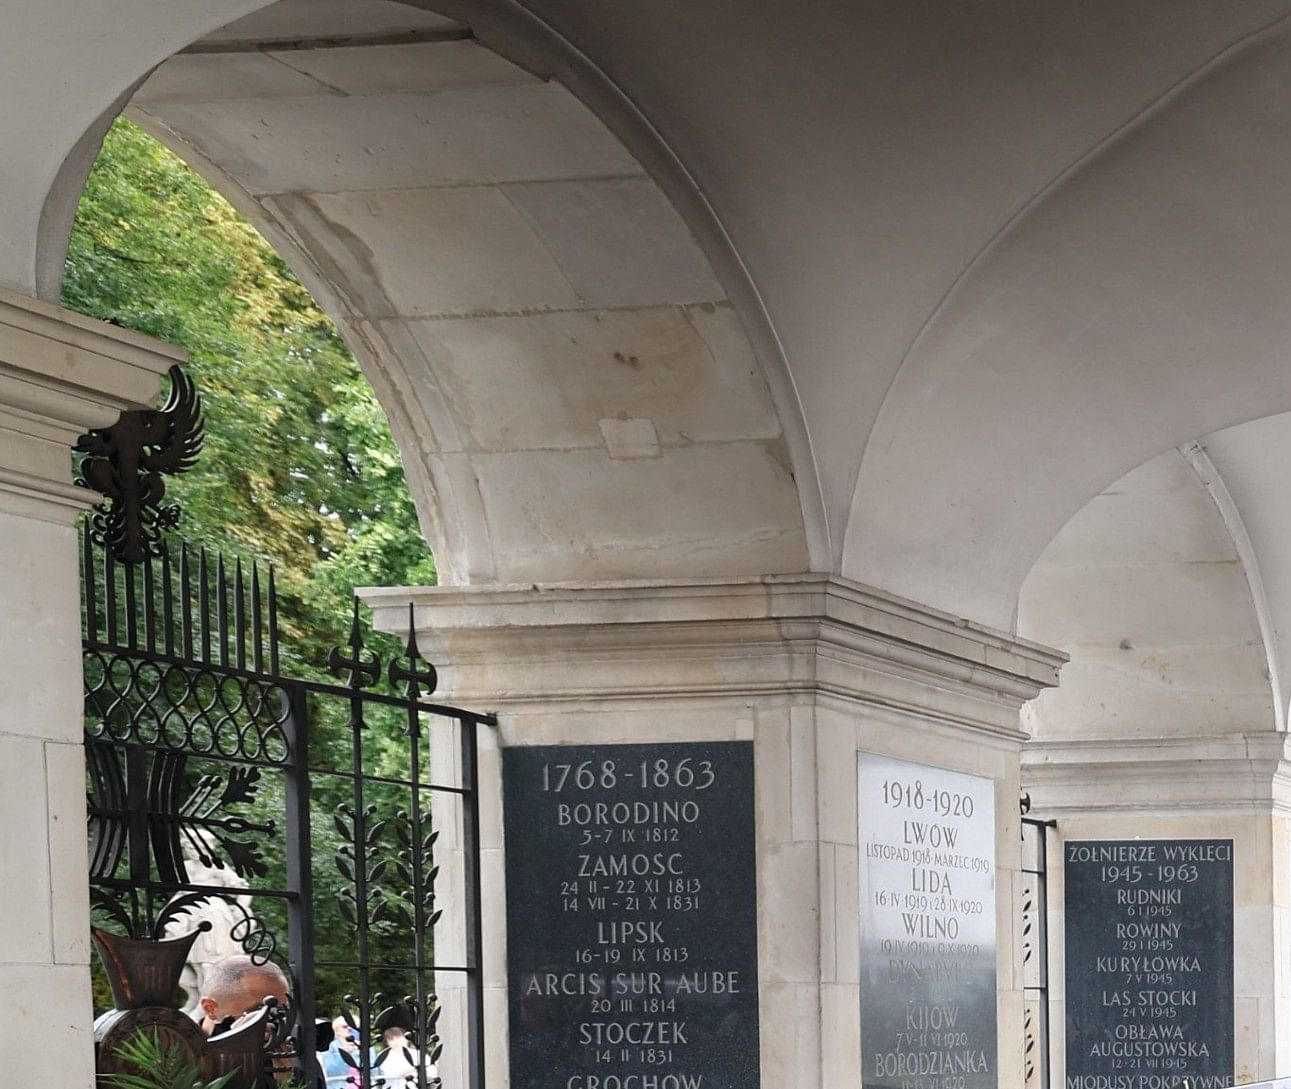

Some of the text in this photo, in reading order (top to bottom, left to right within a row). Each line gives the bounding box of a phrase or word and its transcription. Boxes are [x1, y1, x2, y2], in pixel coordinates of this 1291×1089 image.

[883, 780, 973, 818] 1918-1920
[558, 801, 699, 825] BORODINO
[580, 829, 680, 845] 5-7 IX 1812
[866, 843, 989, 874] LISTOPAD 1919
[1164, 845, 1231, 862] WYKLĘCI
[561, 879, 701, 895] 24 II 22 XI 1813
[912, 868, 952, 895] LIDA
[564, 897, 698, 911] 14 VII 21 X 1831
[1117, 889, 1181, 904] RUDNIKI
[1128, 906, 1172, 916] 6 1945
[598, 922, 664, 944] LIPSK
[902, 913, 958, 939] WILNO
[1116, 923, 1181, 939] ROWINY
[1123, 940, 1173, 950] 29 1945
[575, 948, 688, 964] 16-19 IX 1813
[527, 971, 740, 996] ARCIS SUR AUBE
[1126, 973, 1173, 984] 7 V 1945
[591, 999, 675, 1013] 20 III 1814
[1103, 991, 1197, 1006] LAS STOCKI
[1140, 1008, 1146, 1016] V
[1151, 1008, 1176, 1018] 1945
[580, 1023, 688, 1044] STOCZEK
[1116, 1025, 1183, 1039] OBŁAWA
[596, 1050, 673, 1064] 14 II 1831
[1090, 1042, 1209, 1056] AUGUSTOWSKA
[876, 1050, 988, 1077] BORODZIANKA
[1146, 1058, 1187, 1069] VII 1945
